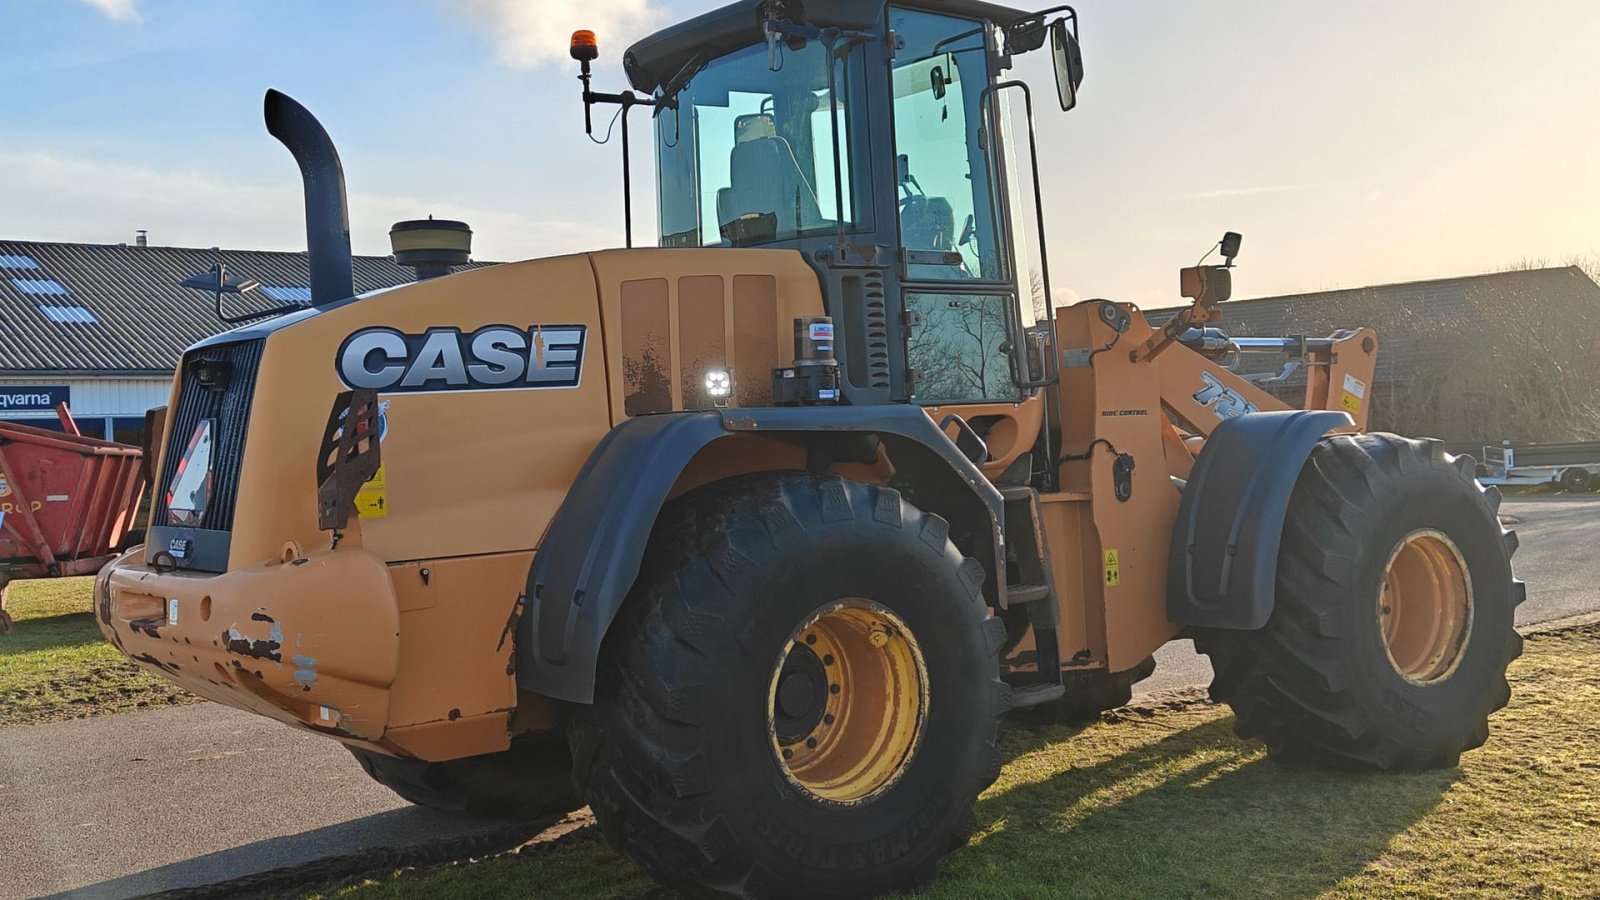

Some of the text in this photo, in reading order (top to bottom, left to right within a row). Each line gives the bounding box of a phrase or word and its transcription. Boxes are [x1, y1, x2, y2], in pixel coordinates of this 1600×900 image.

[341, 331, 582, 389] CASE
[1192, 371, 1258, 420] 72
[170, 539, 187, 551] CASE
